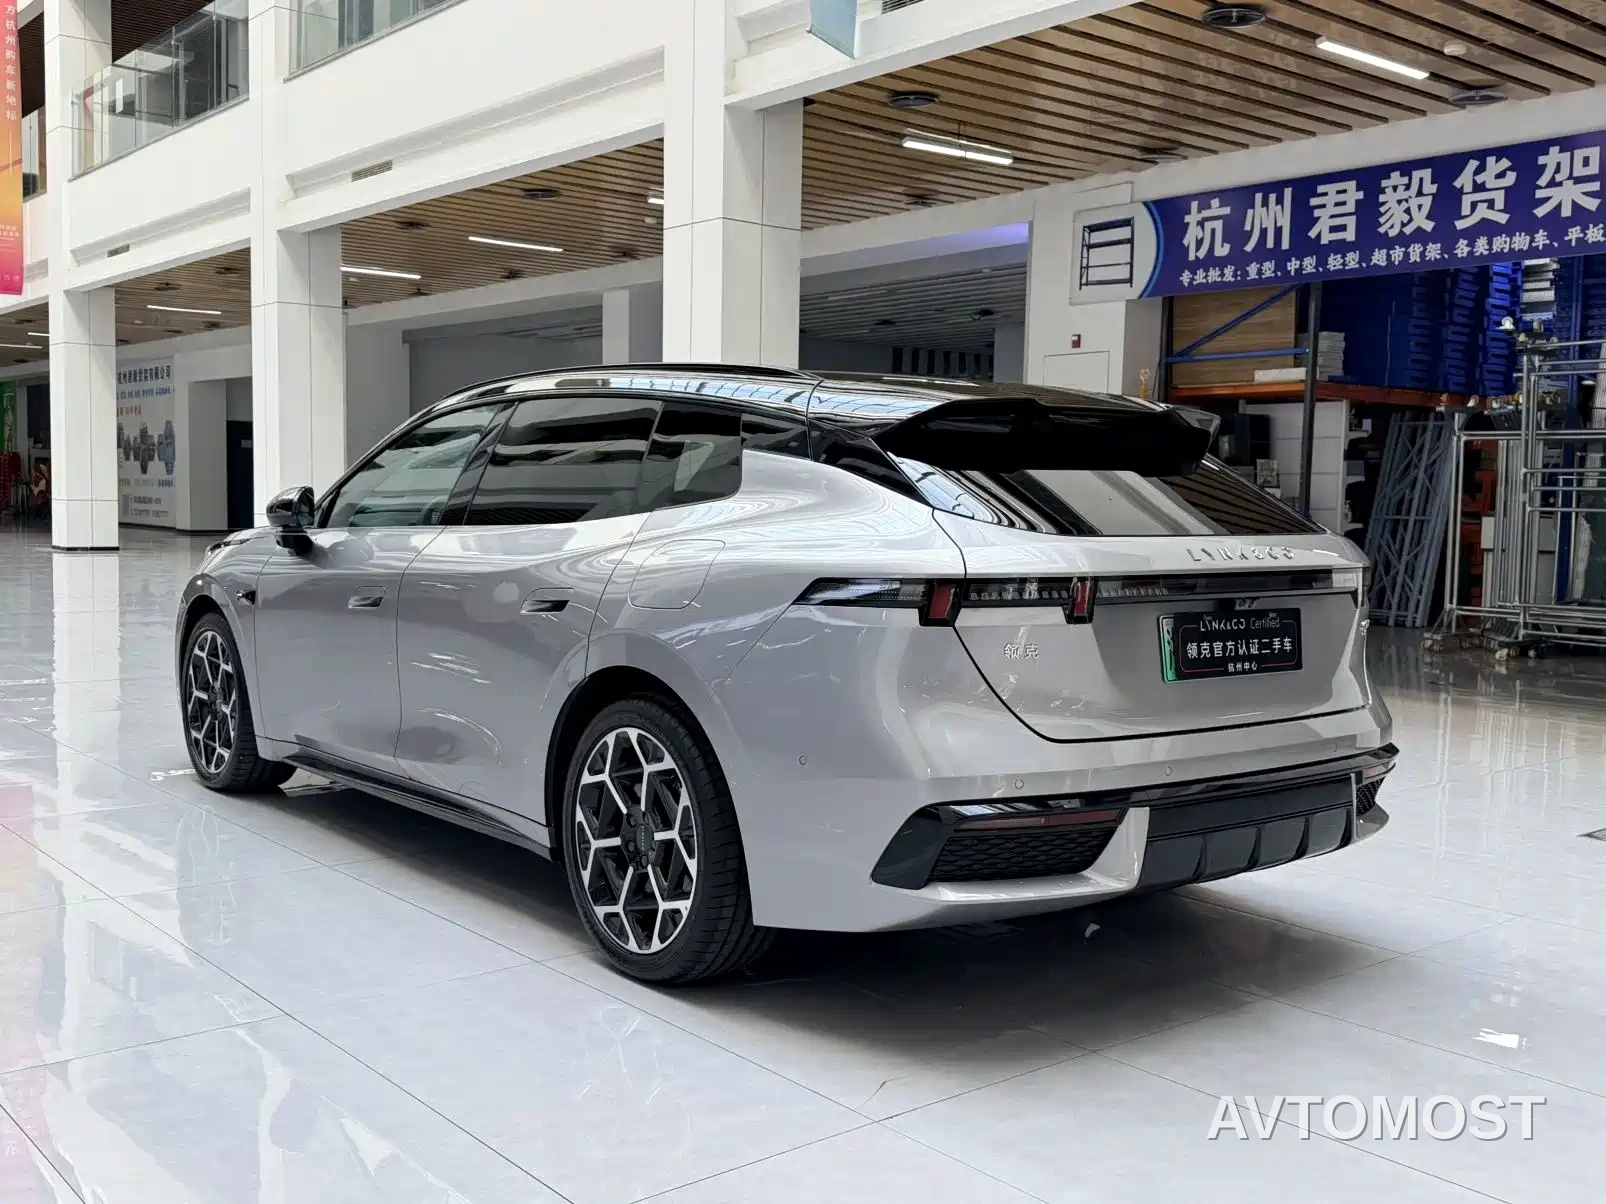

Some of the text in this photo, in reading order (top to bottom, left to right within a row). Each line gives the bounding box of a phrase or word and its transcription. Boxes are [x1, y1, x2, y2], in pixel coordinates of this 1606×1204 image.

[1182, 145, 1602, 261] 杭州君毅货架
[1200, 617, 1280, 632] LYNK&CO Certified
[1004, 643, 1040, 660] 领克
[1186, 636, 1293, 659] 领克官方认证二手车
[1227, 661, 1258, 673] 杭州中心
